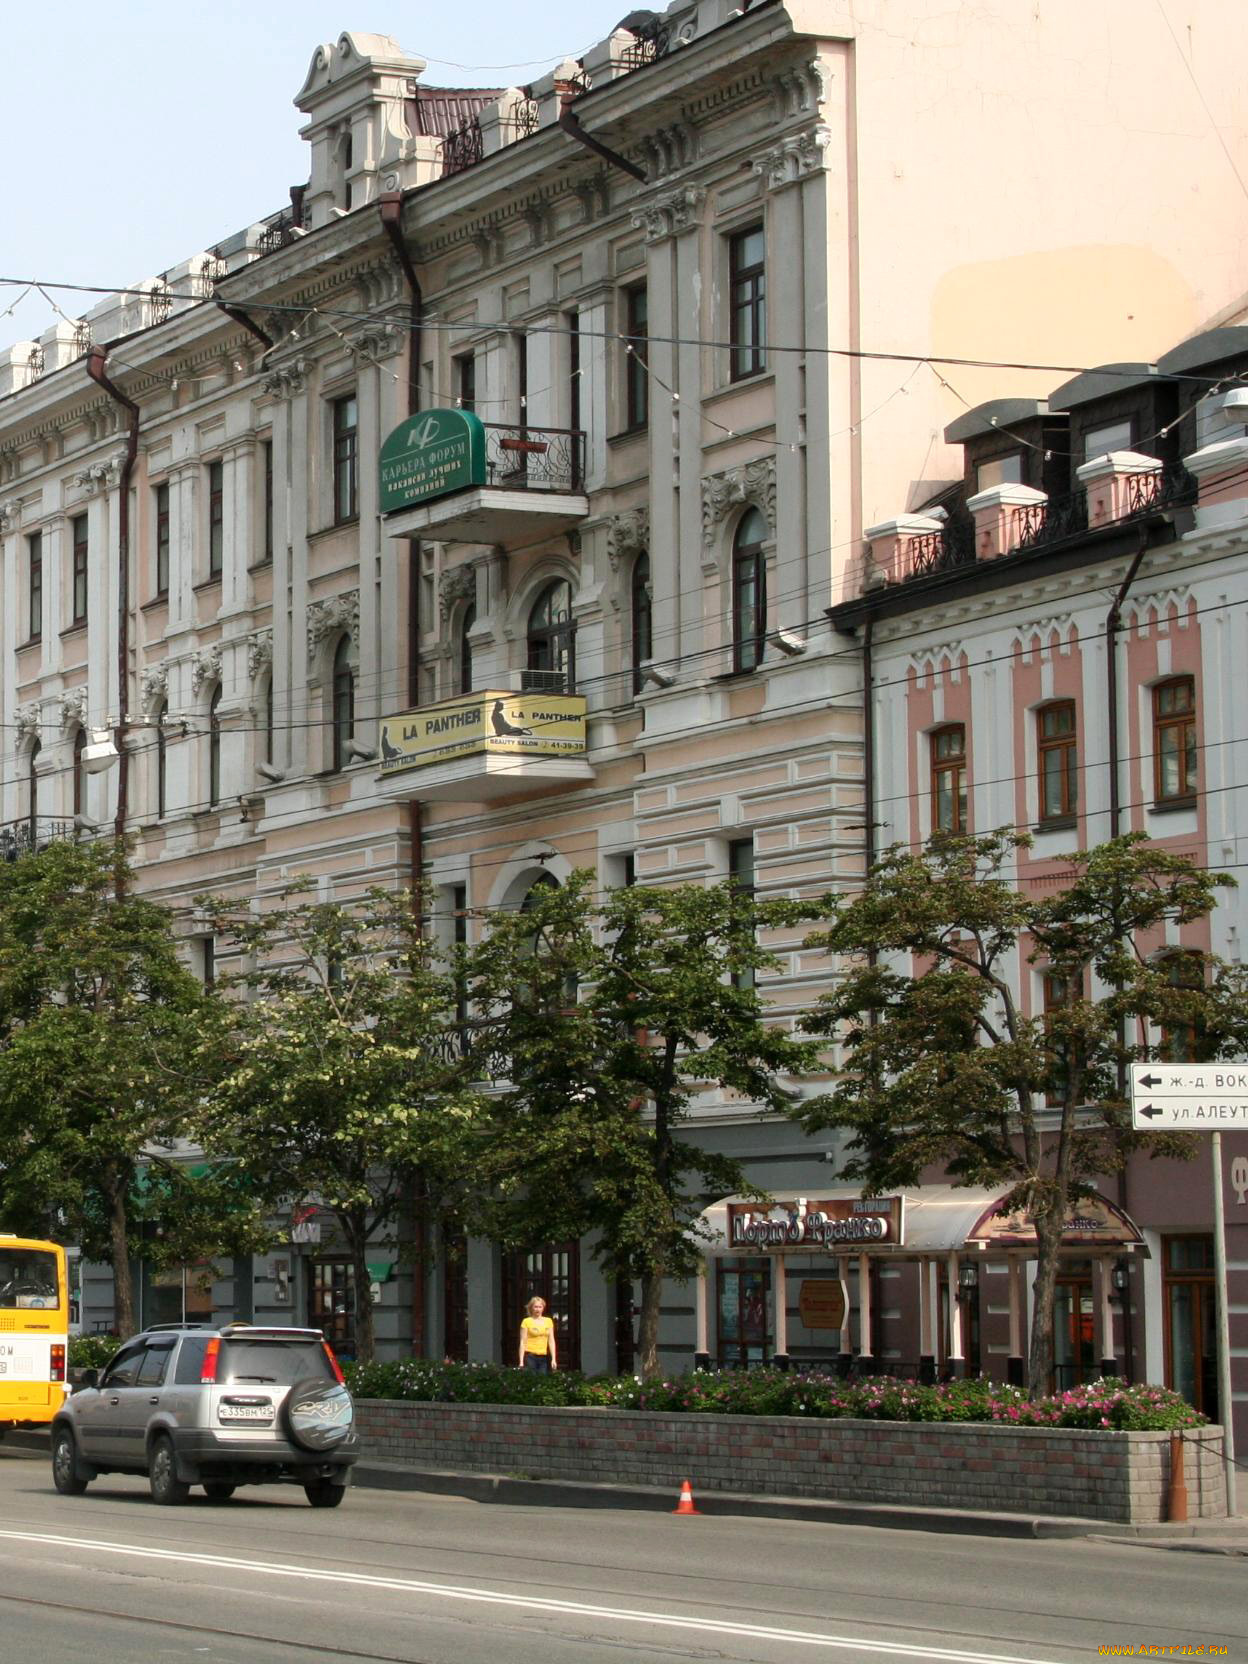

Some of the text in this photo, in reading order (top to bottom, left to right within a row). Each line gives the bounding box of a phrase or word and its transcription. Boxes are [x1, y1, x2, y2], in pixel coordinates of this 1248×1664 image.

[382, 442, 465, 482] КАРЬЕРА ФОРУМ
[429, 460, 461, 479] лучших
[405, 475, 445, 499] компаний
[403, 708, 481, 740] LA PANTHER
[512, 711, 581, 722] LA PANTHER
